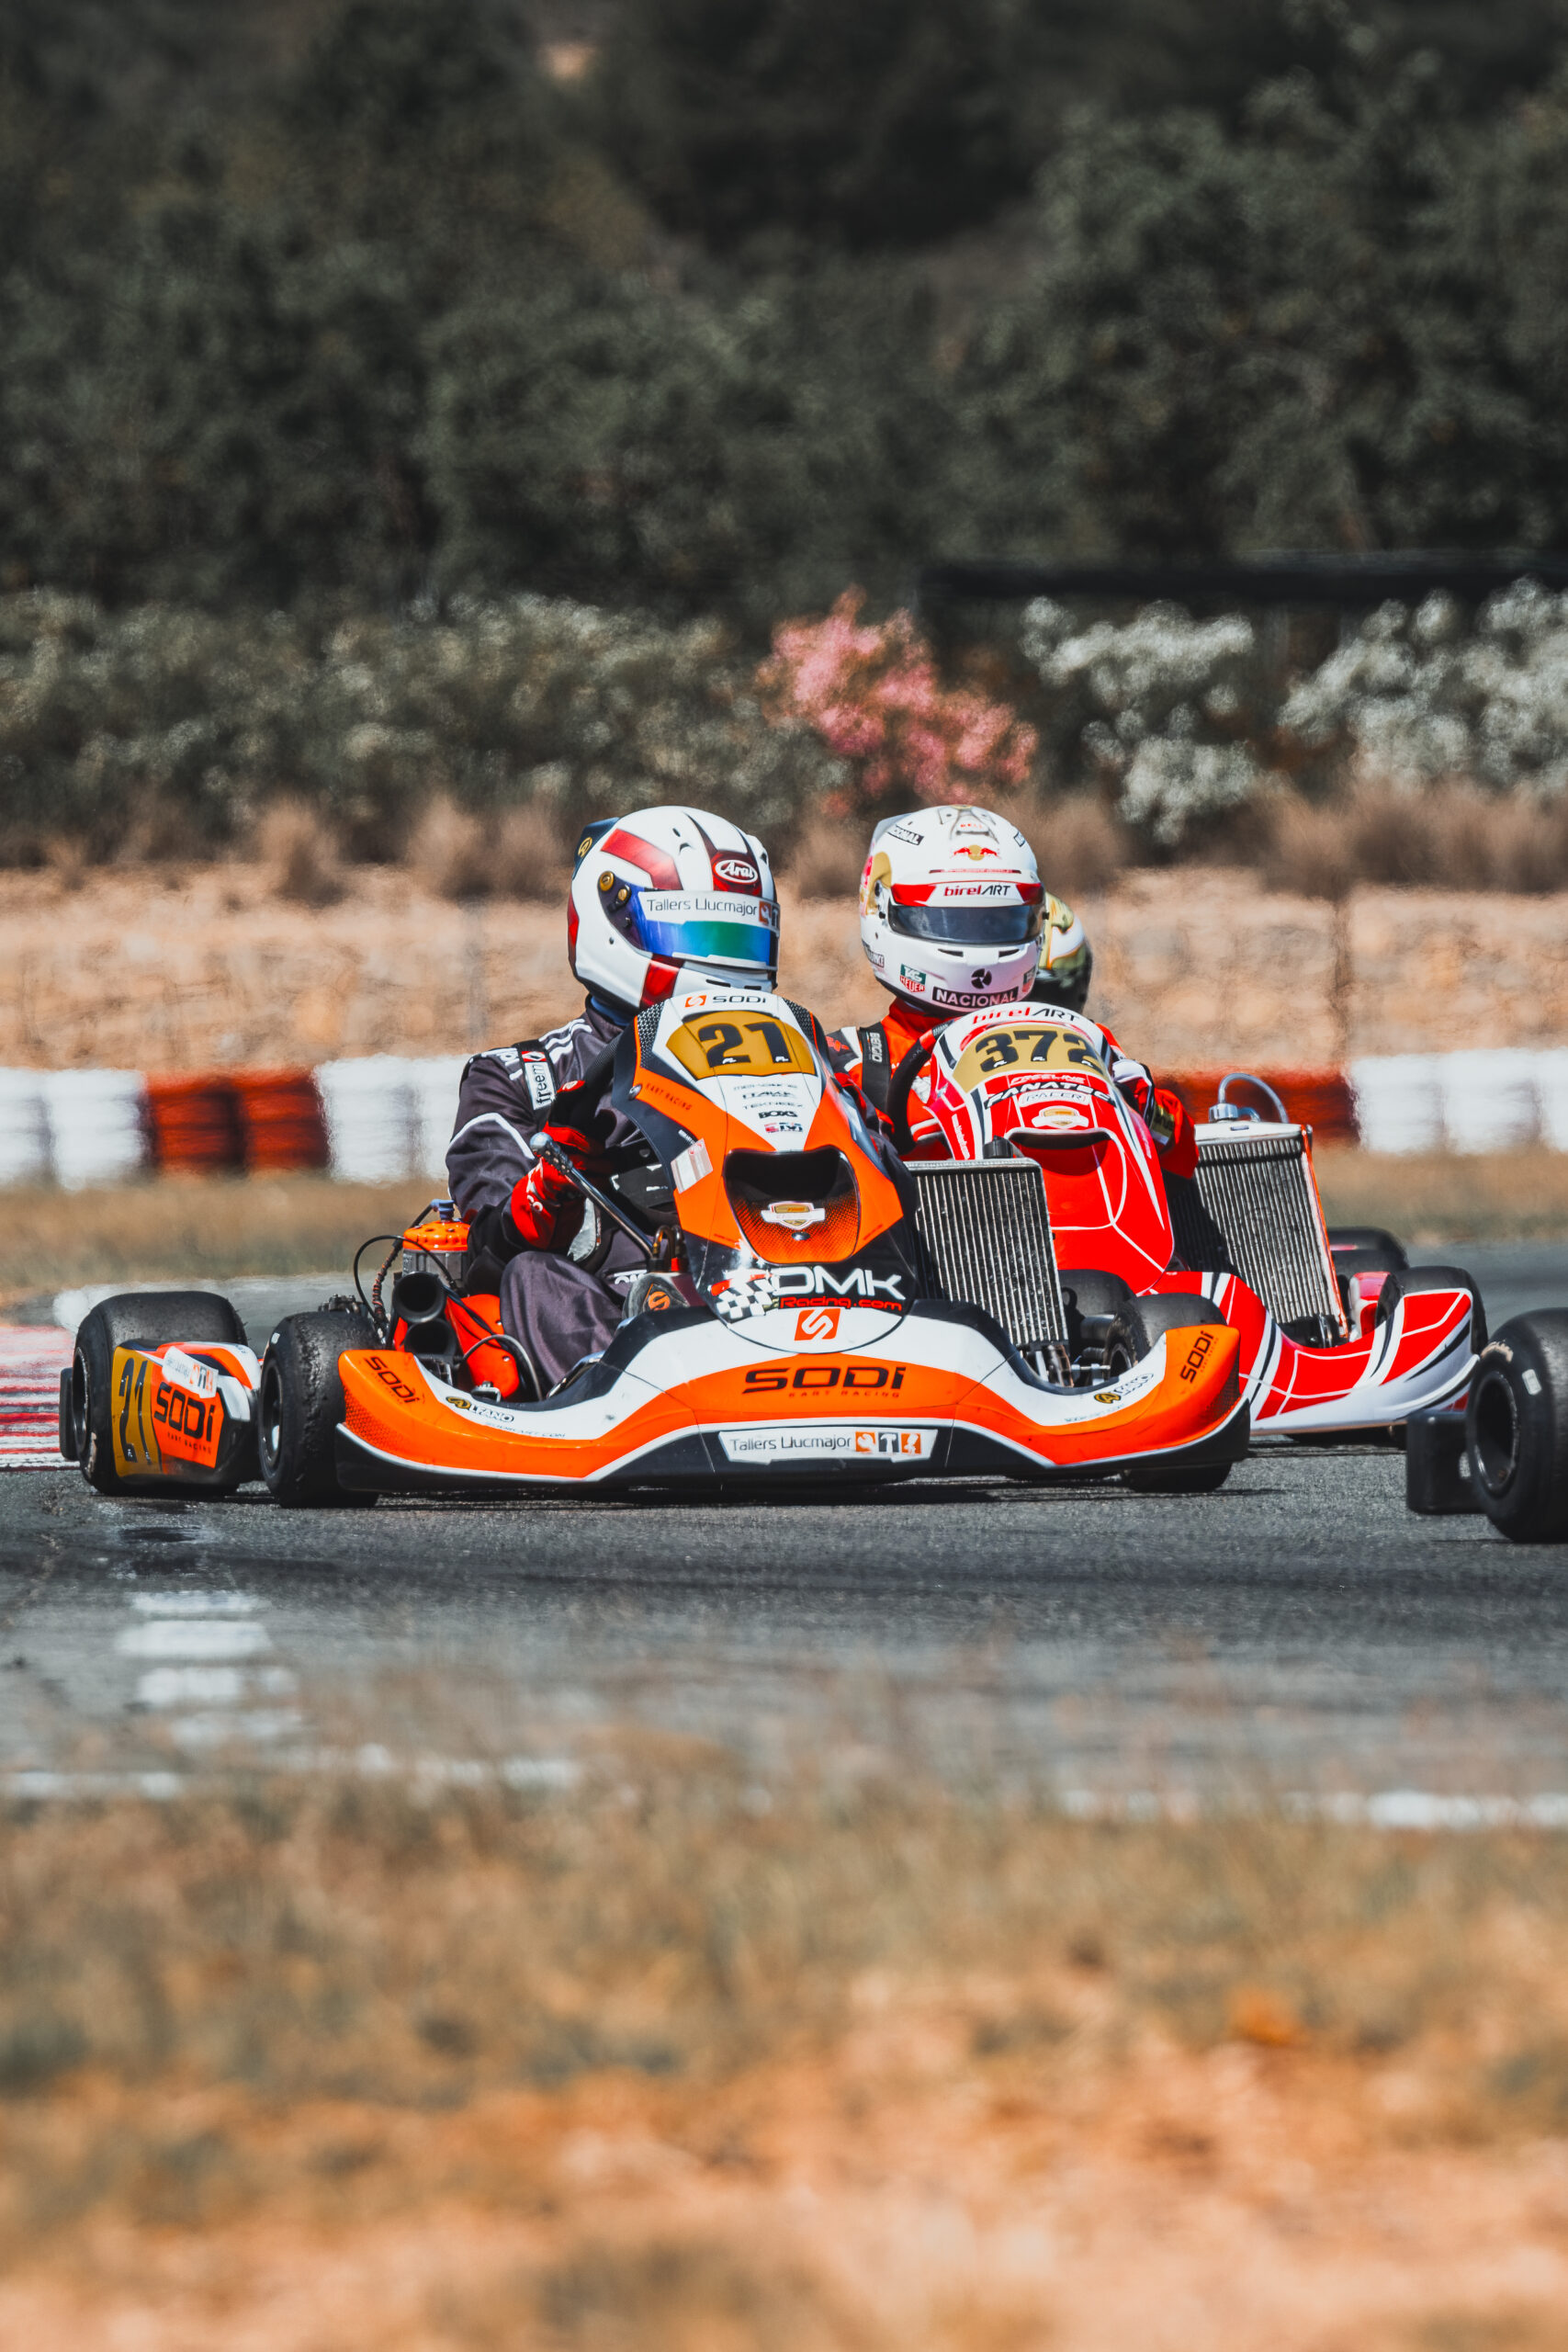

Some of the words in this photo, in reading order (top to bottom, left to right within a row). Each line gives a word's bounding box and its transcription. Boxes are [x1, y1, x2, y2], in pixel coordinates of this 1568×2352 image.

[720, 861, 755, 878] Arai
[646, 898, 691, 912] Tallers
[900, 976, 925, 992] HEUER
[935, 989, 1016, 1008] NACIONAL
[697, 1021, 792, 1069] 21
[976, 1030, 1108, 1075] 372
[987, 1082, 1113, 1110] FANATEC
[771, 1265, 906, 1300] DMK
[780, 1295, 902, 1311] Racing.com
[118, 1357, 152, 1465] 21
[729, 1437, 777, 1452] Tallers
